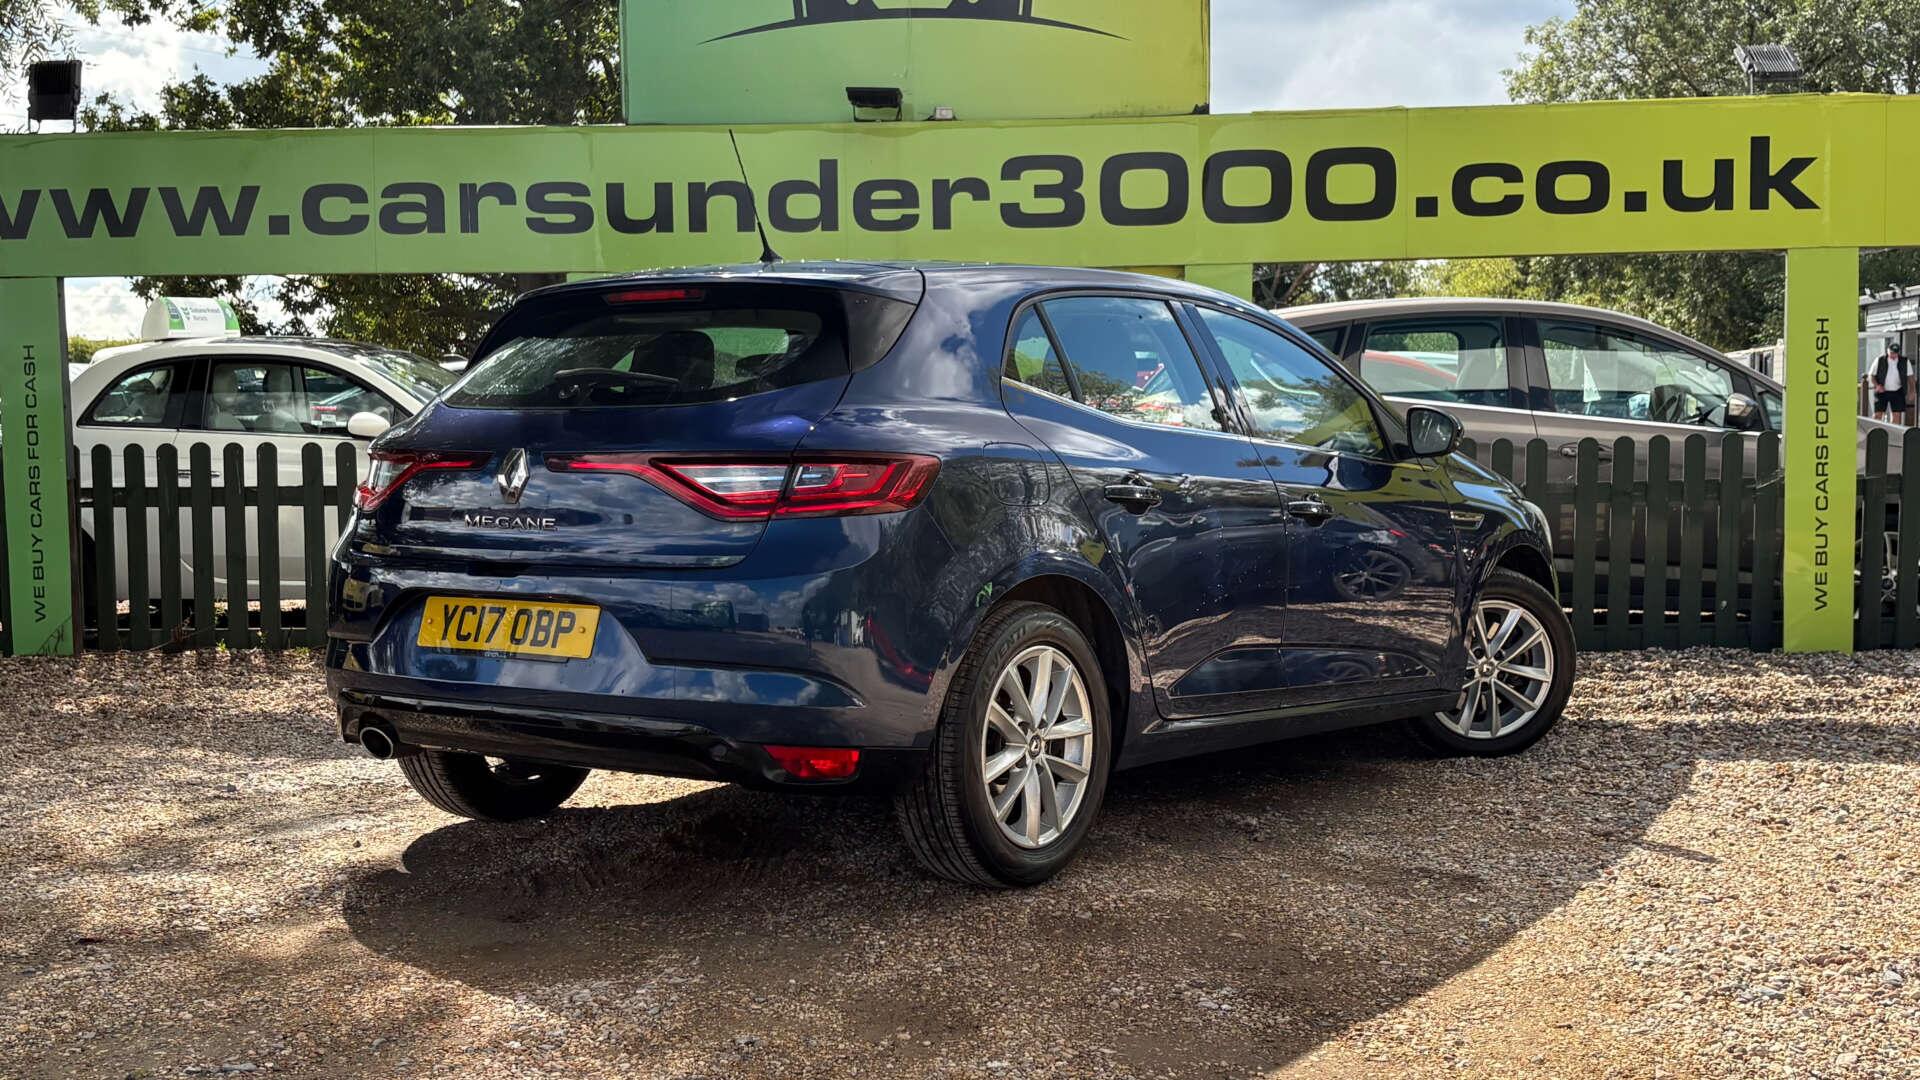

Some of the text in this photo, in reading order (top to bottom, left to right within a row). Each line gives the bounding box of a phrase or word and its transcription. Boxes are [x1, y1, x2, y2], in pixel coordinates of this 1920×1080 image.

[23, 344, 46, 623] WE BUY CARS FOR CASH
[464, 514, 558, 531] MEGANE
[1814, 318, 1830, 612] WE BUY CARS FOR CASH
[441, 604, 577, 649] YC17 OBP
